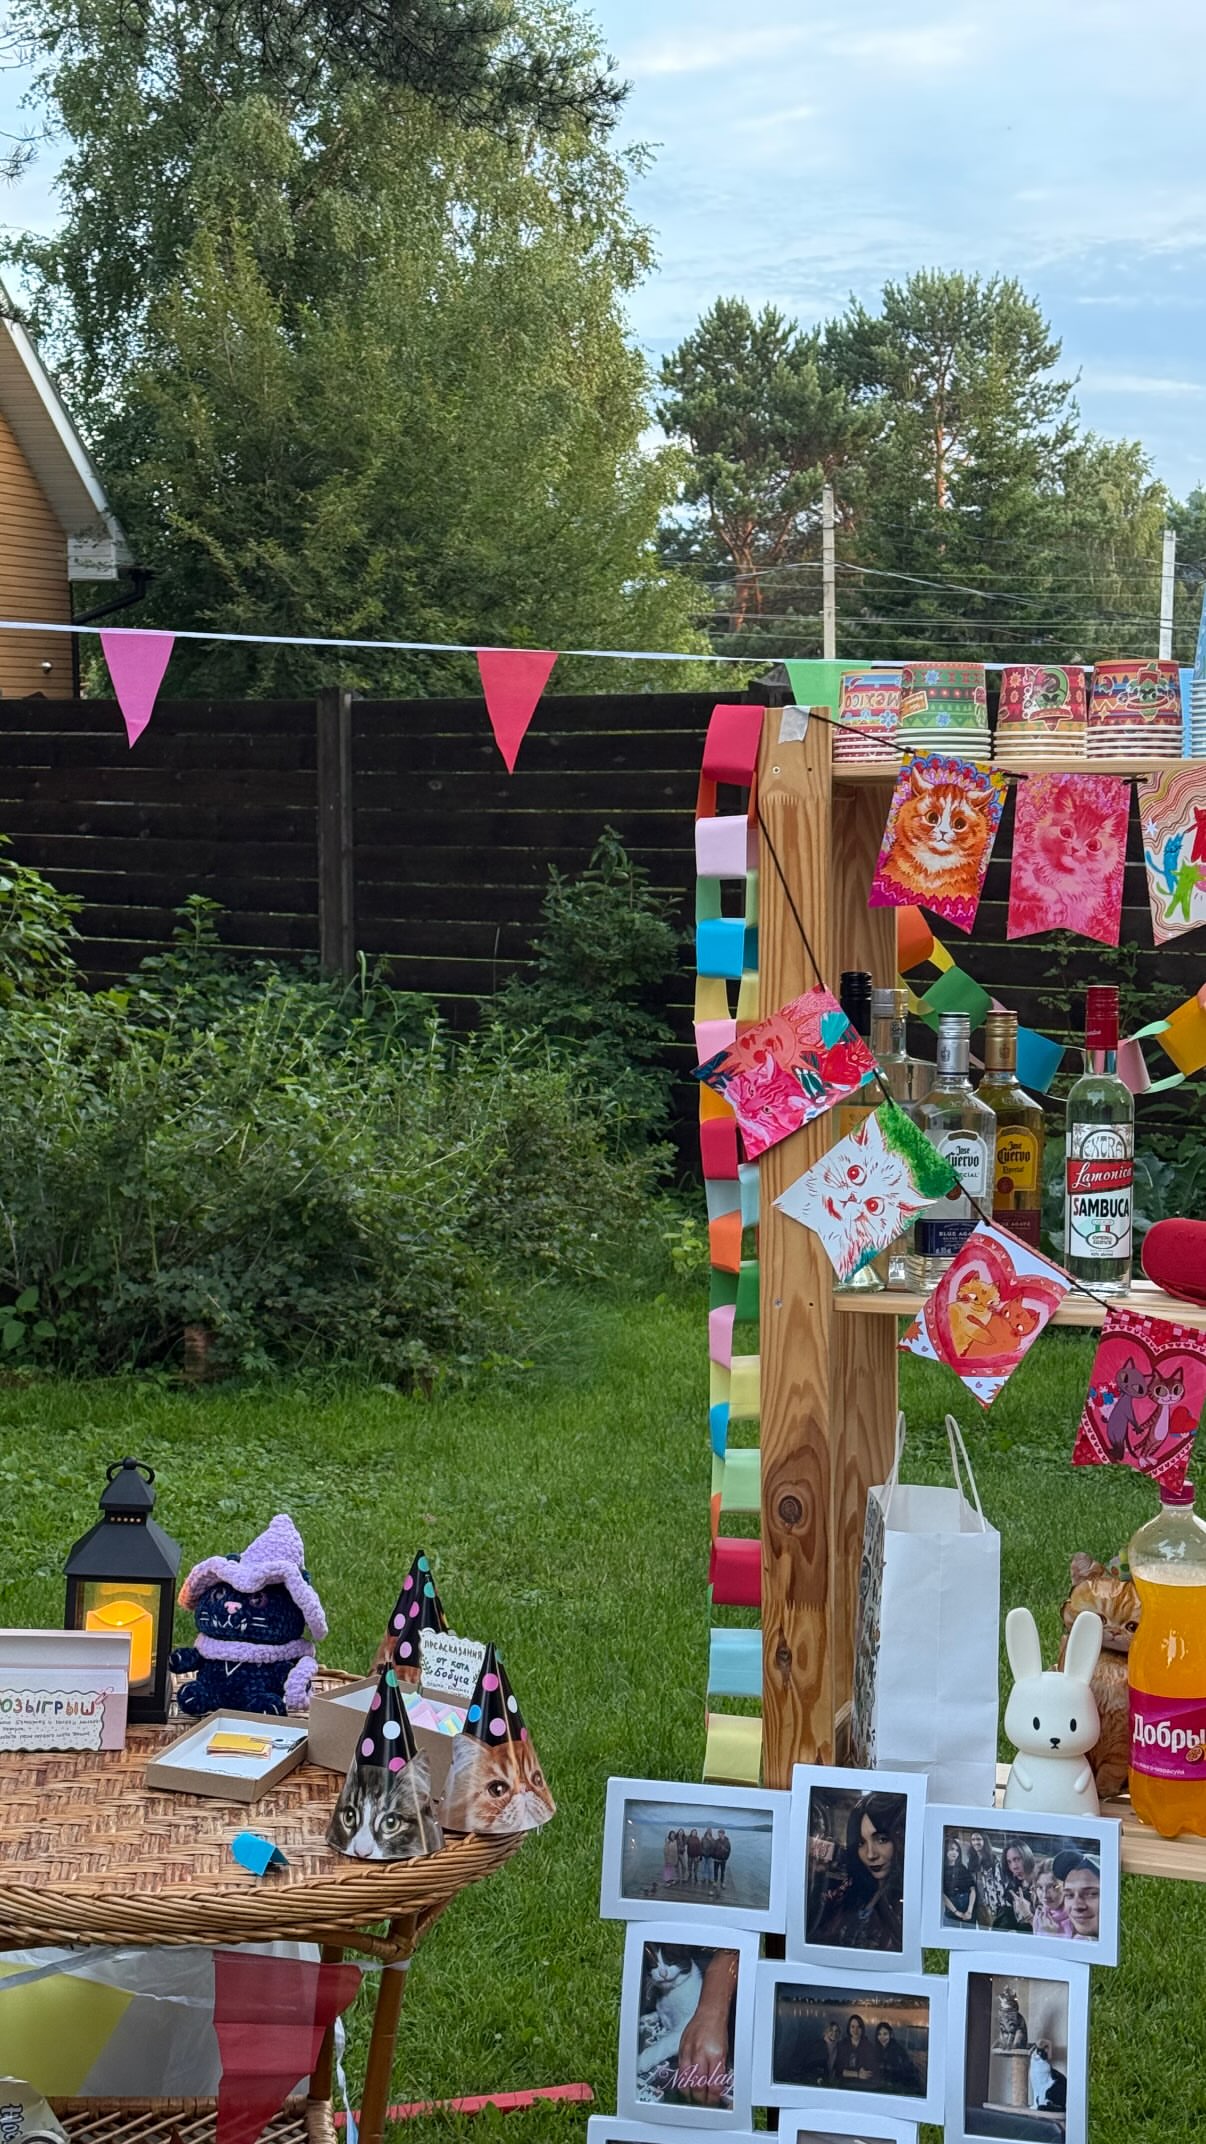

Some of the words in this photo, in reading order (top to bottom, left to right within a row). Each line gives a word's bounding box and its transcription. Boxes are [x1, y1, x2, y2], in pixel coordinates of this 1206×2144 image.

[956, 1145, 970, 1156] Jose
[997, 1147, 1031, 1164] Cuervo
[1083, 1136, 1122, 1158] EXTRA
[1072, 1162, 1132, 1189] Lamonica
[1073, 1198, 1129, 1217] SAMBUCA
[0, 1698, 95, 1716] ОЗЫГРЫШ
[1133, 1713, 1206, 1753] Добры
